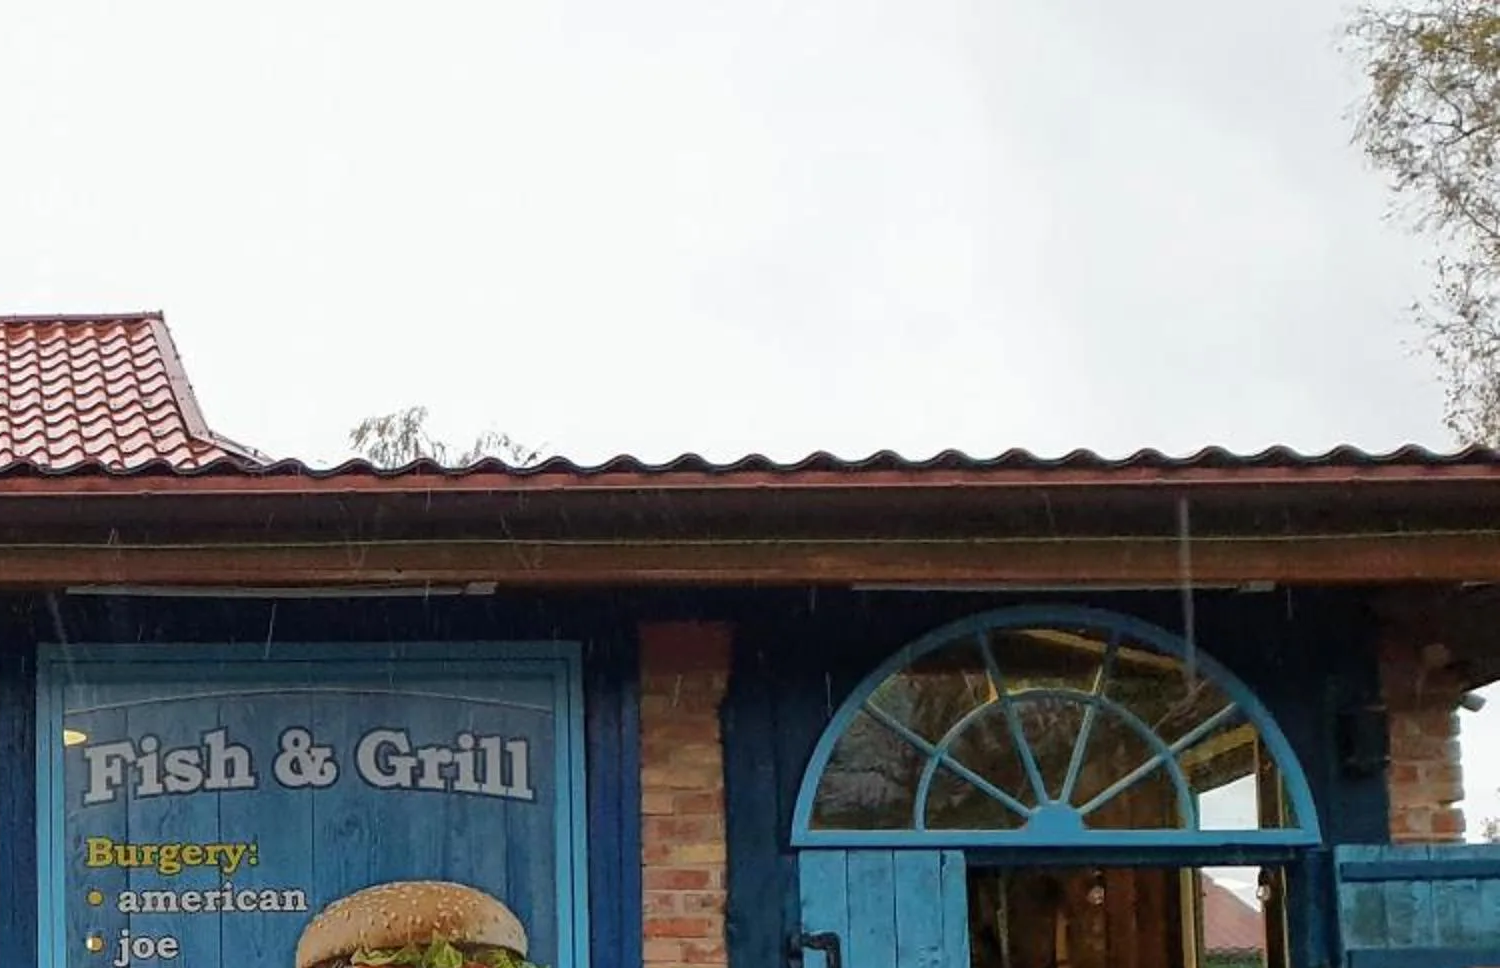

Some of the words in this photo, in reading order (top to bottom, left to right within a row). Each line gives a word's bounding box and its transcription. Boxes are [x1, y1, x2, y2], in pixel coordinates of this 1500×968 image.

[83, 728, 255, 805] Fish
[274, 727, 338, 788] &
[356, 729, 536, 801] Grill
[85, 838, 259, 874] Burgery:
[117, 882, 308, 913] american
[114, 929, 179, 967] joe
